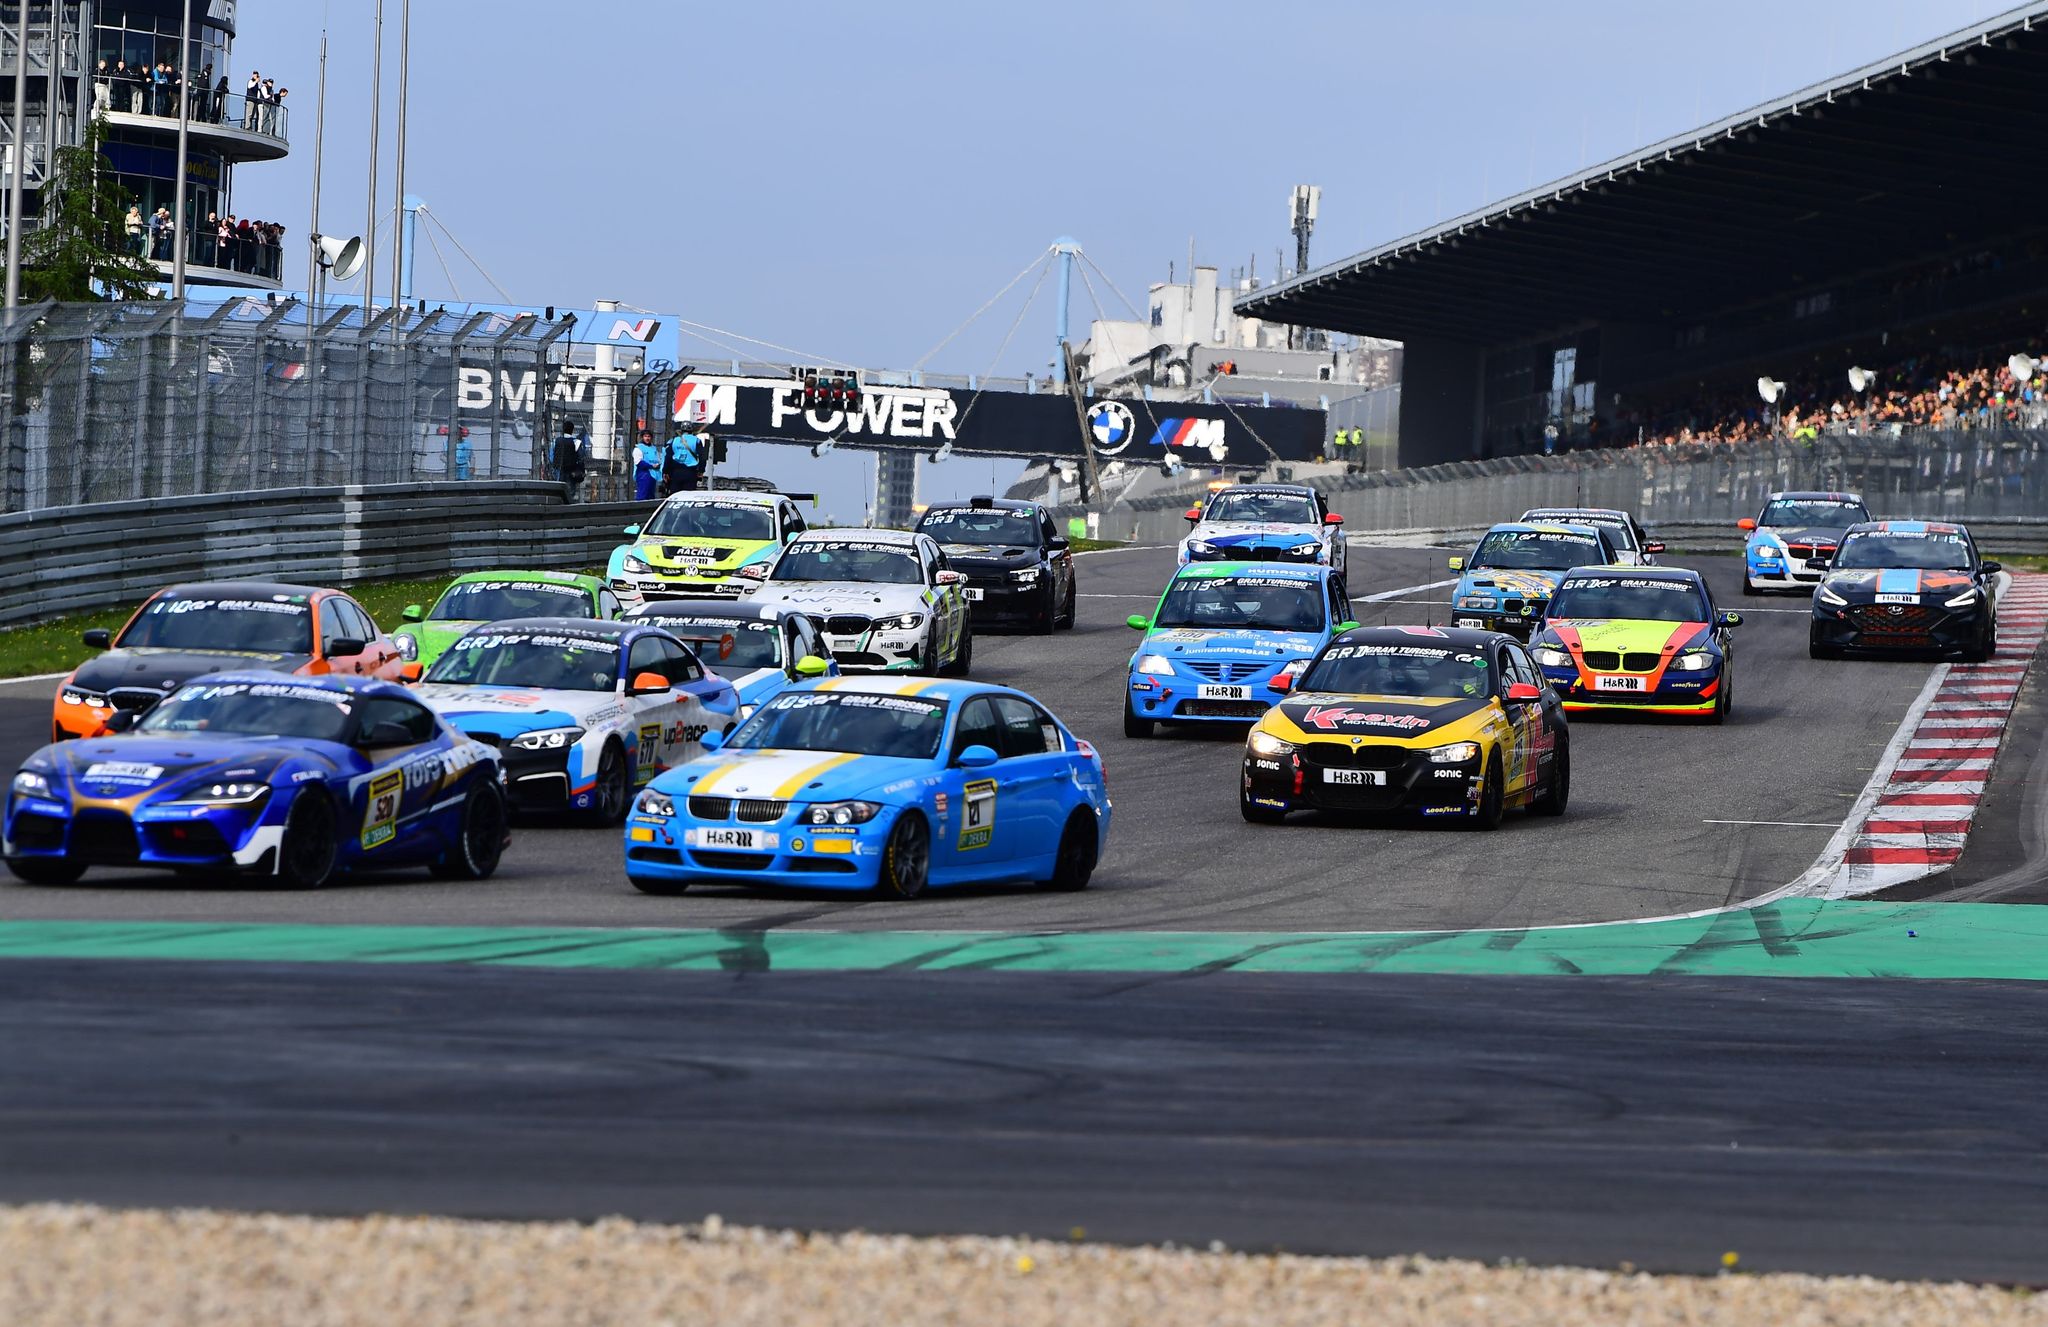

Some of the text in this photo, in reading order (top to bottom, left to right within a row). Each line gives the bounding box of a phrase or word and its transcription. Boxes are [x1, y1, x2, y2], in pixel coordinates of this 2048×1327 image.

[457, 367, 590, 412] BMW
[771, 387, 958, 438] POWER
[923, 515, 955, 526] GRD
[677, 547, 715, 556] RACING
[788, 542, 825, 555] GRD
[849, 543, 874, 551] GRAN
[875, 544, 913, 554] TURISMO
[511, 582, 540, 590] GRAN
[542, 584, 585, 596] TURISMO
[1266, 579, 1307, 588] TURISMO
[1562, 579, 1601, 590] GRD
[1621, 579, 1645, 587] GRAN
[1648, 581, 1687, 591] TURISMO
[662, 617, 691, 625] GRAN
[692, 618, 740, 627] TURISMO
[1323, 645, 1365, 661] GRD
[1365, 646, 1396, 654] GRAN
[1400, 646, 1447, 657] TURISMO
[840, 695, 874, 704] GRAN
[878, 697, 936, 712] TURISMO
[1343, 719, 1415, 730] MOTORSPORT
[1255, 798, 1285, 807] GOODYEAR
[1426, 806, 1462, 814] GOODYEAR
